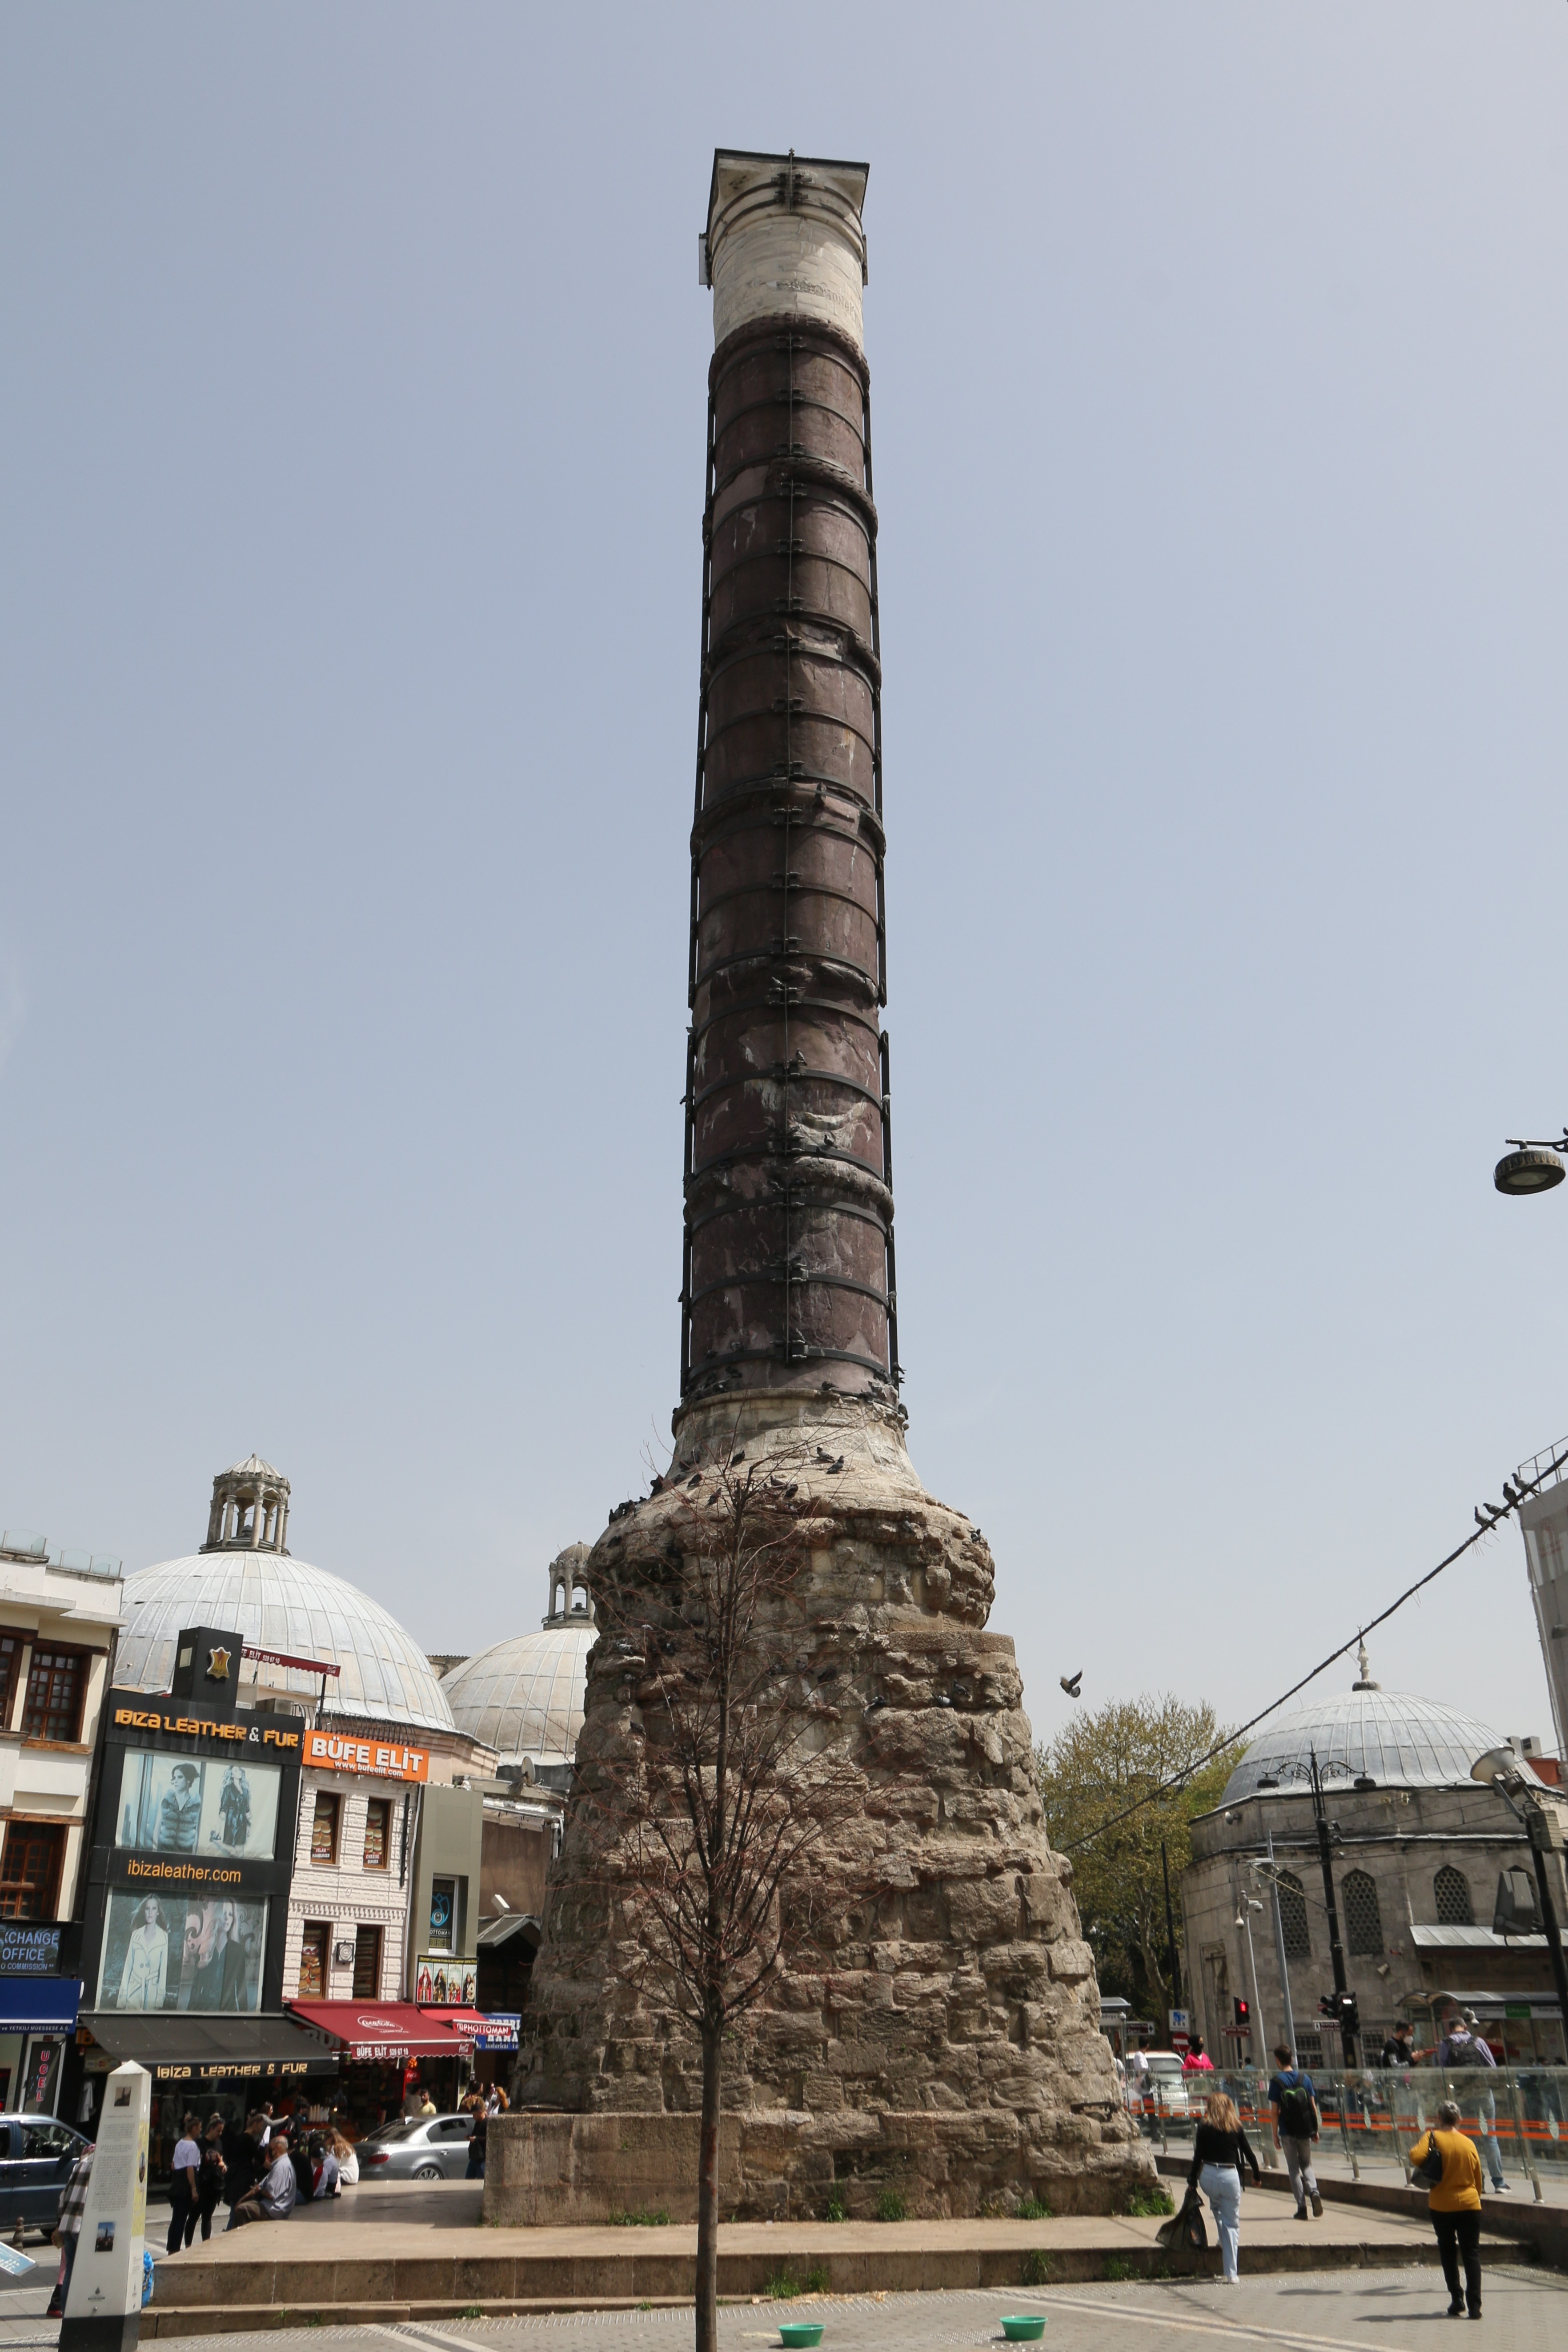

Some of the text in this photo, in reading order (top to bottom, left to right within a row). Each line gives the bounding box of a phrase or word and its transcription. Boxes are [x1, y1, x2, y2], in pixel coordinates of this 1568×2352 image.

[249, 1650, 261, 1660] ELİT
[249, 1727, 259, 1742] &
[262, 1730, 299, 1747] FUR
[311, 1736, 423, 1771] BÜFE ELİT
[128, 1859, 242, 1882] ibizaleather.com
[5, 1931, 61, 1946] CHANGE
[2, 1947, 45, 1961] OFFICE
[7, 1963, 48, 1971] COMMISSION
[464, 2024, 509, 2034] PHOTTOMAN
[357, 2046, 372, 2057] BÜFE
[374, 2045, 387, 2056] ELİT
[267, 2063, 275, 2075] &
[281, 2063, 308, 2074] FUR
